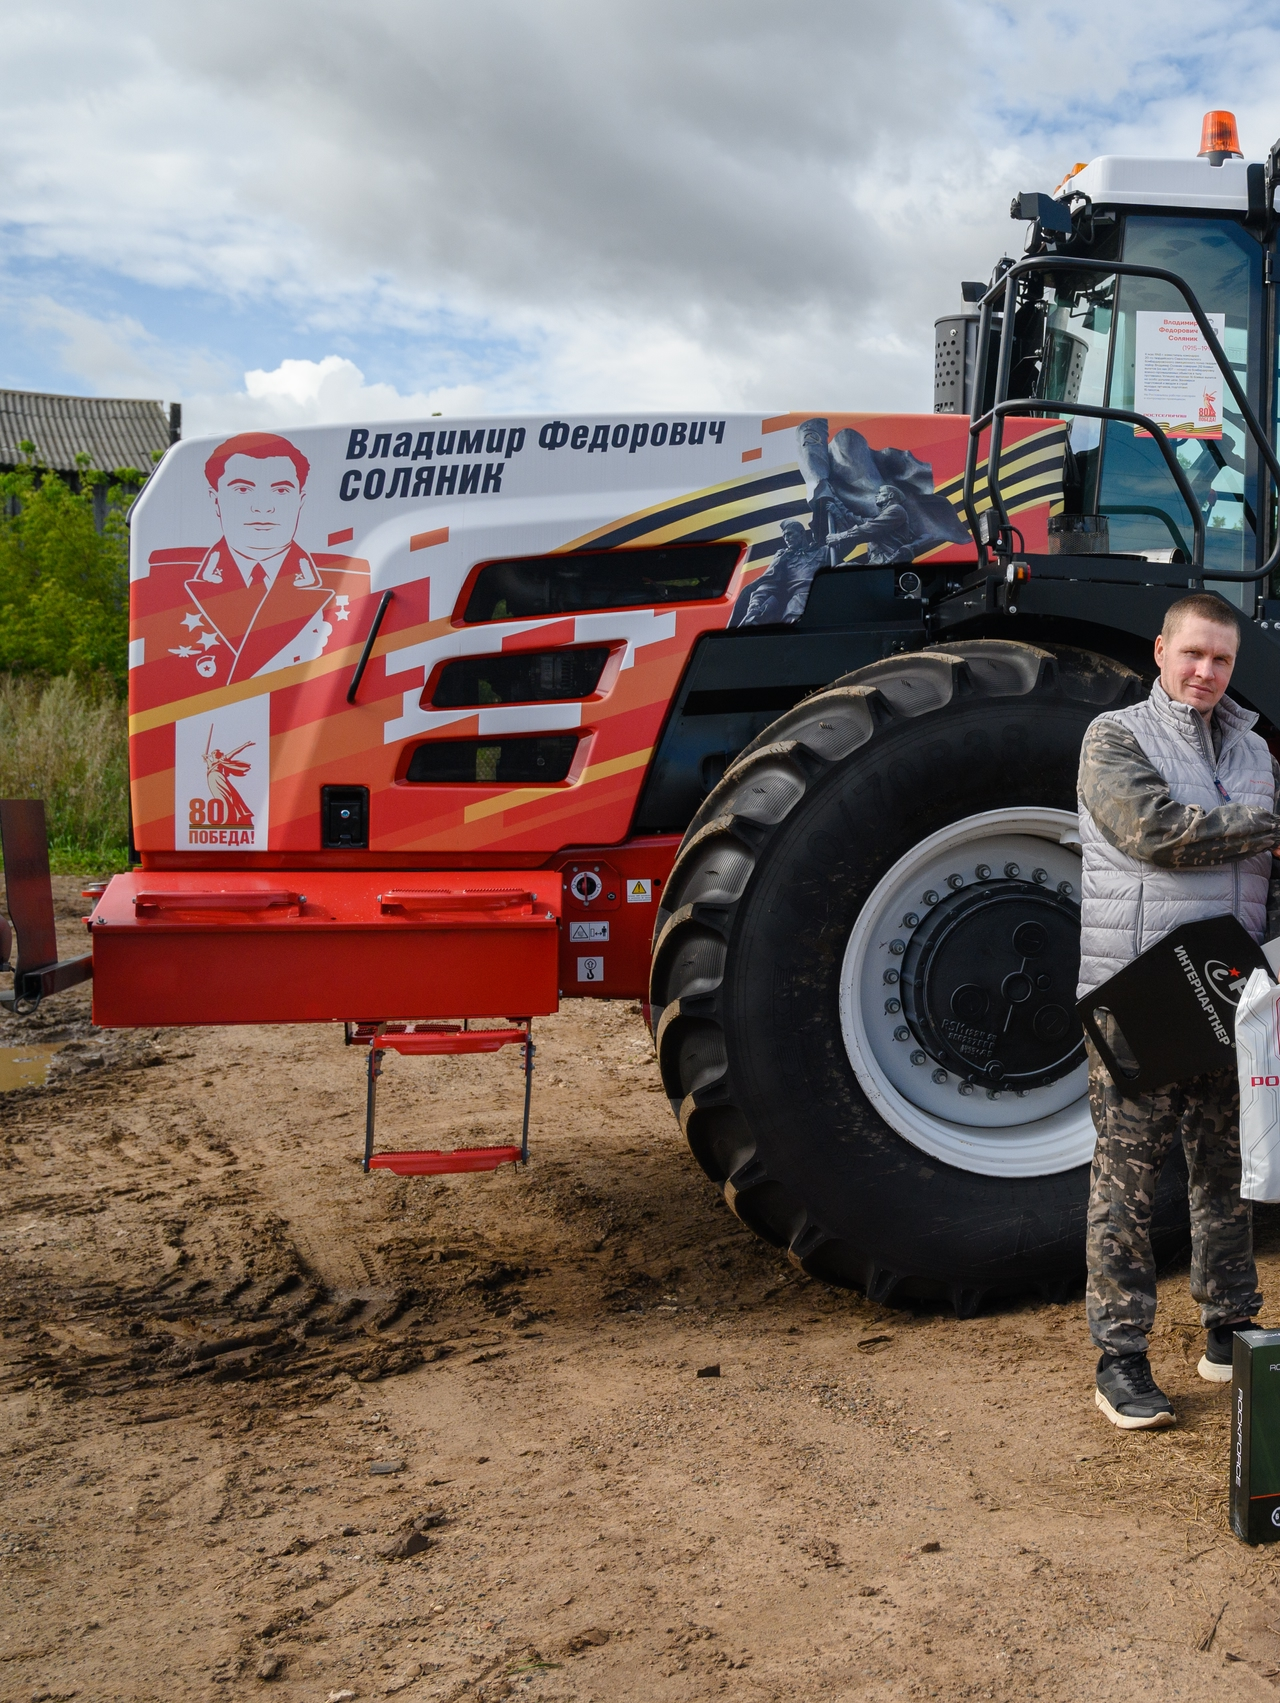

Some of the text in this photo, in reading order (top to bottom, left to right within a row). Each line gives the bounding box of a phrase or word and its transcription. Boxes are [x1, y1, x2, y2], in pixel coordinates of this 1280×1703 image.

[346, 420, 727, 459] Владимир Федорович
[339, 462, 505, 501] СОЛЯНИК
[189, 798, 224, 825] 80
[189, 830, 255, 846] ПОБЕДА!
[1173, 945, 1231, 1045] ИНТЕРПАРТНЕР
